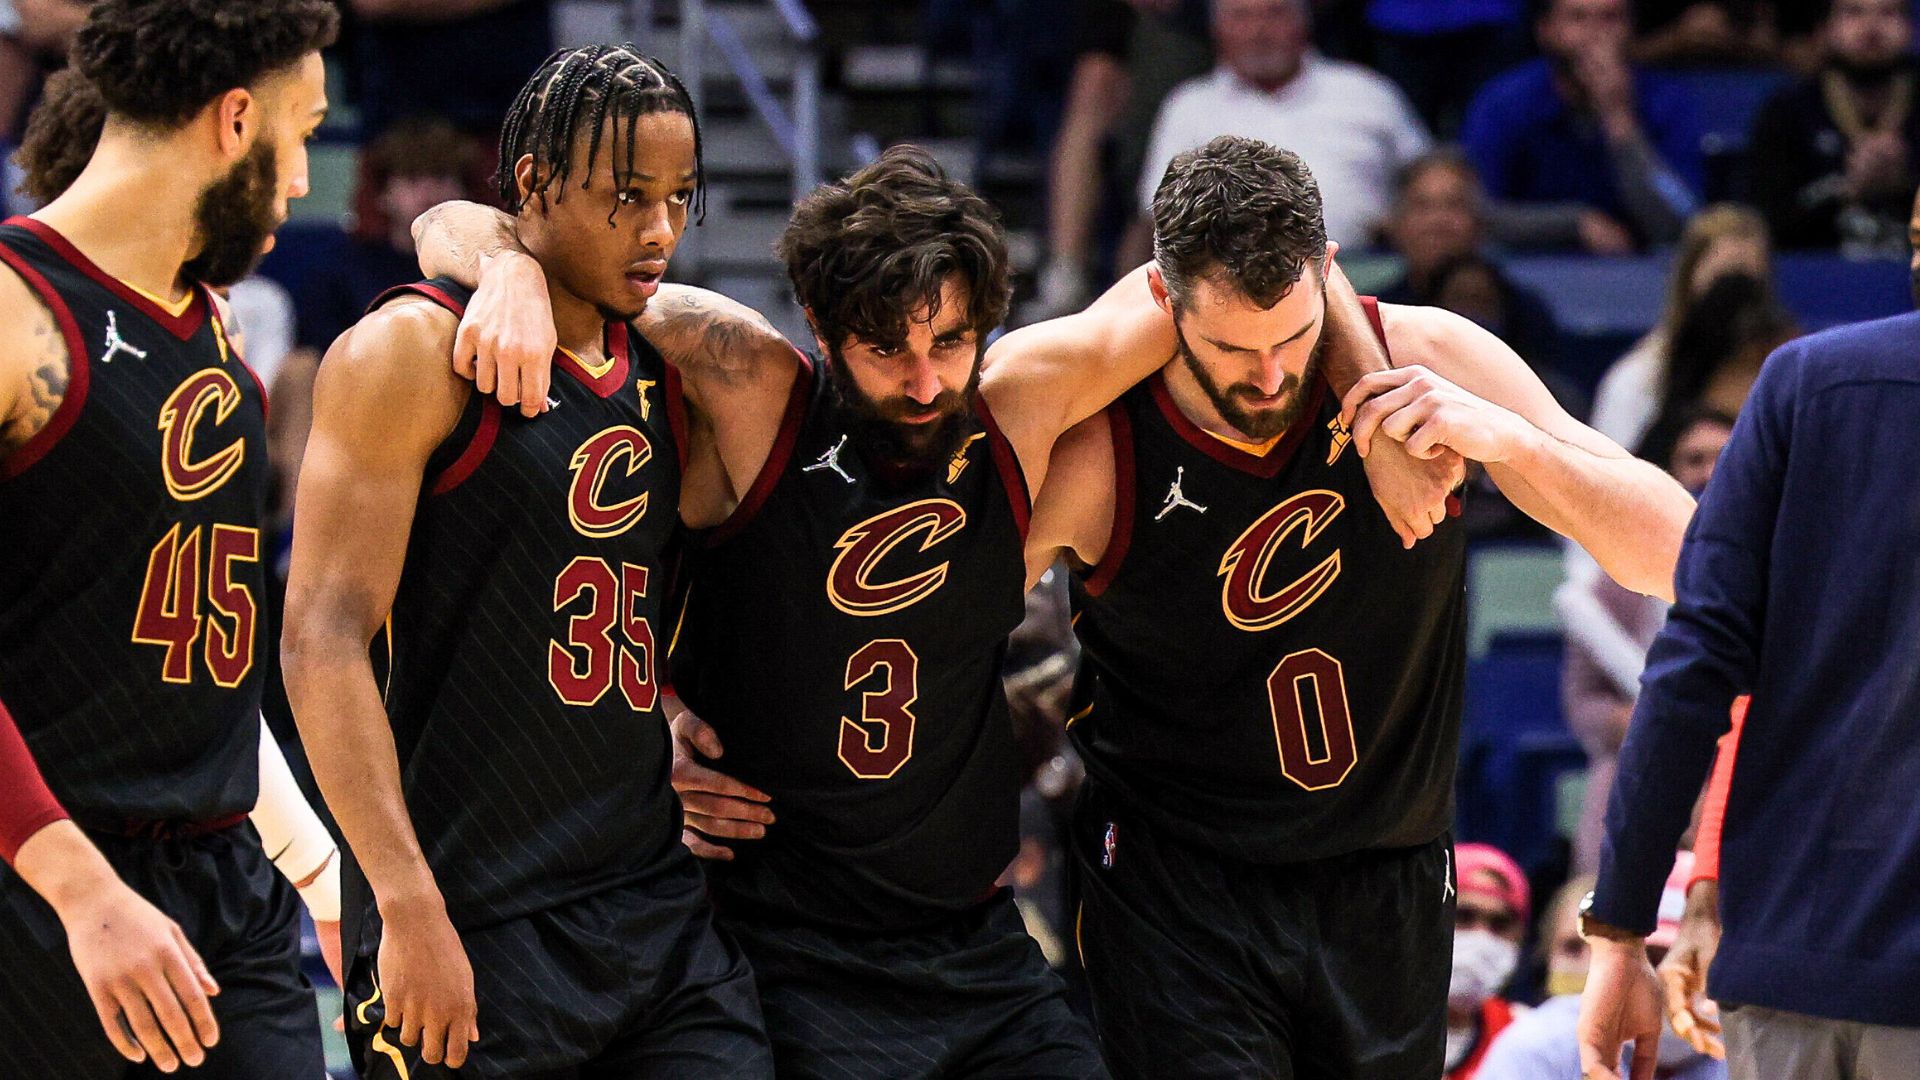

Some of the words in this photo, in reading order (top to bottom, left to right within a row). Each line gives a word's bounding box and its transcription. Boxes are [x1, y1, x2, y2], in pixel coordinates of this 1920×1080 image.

[131, 521, 260, 689] 45
[826, 498, 967, 616] C
[1217, 488, 1346, 632] C
[547, 555, 659, 712] 35
[837, 638, 919, 779] 3
